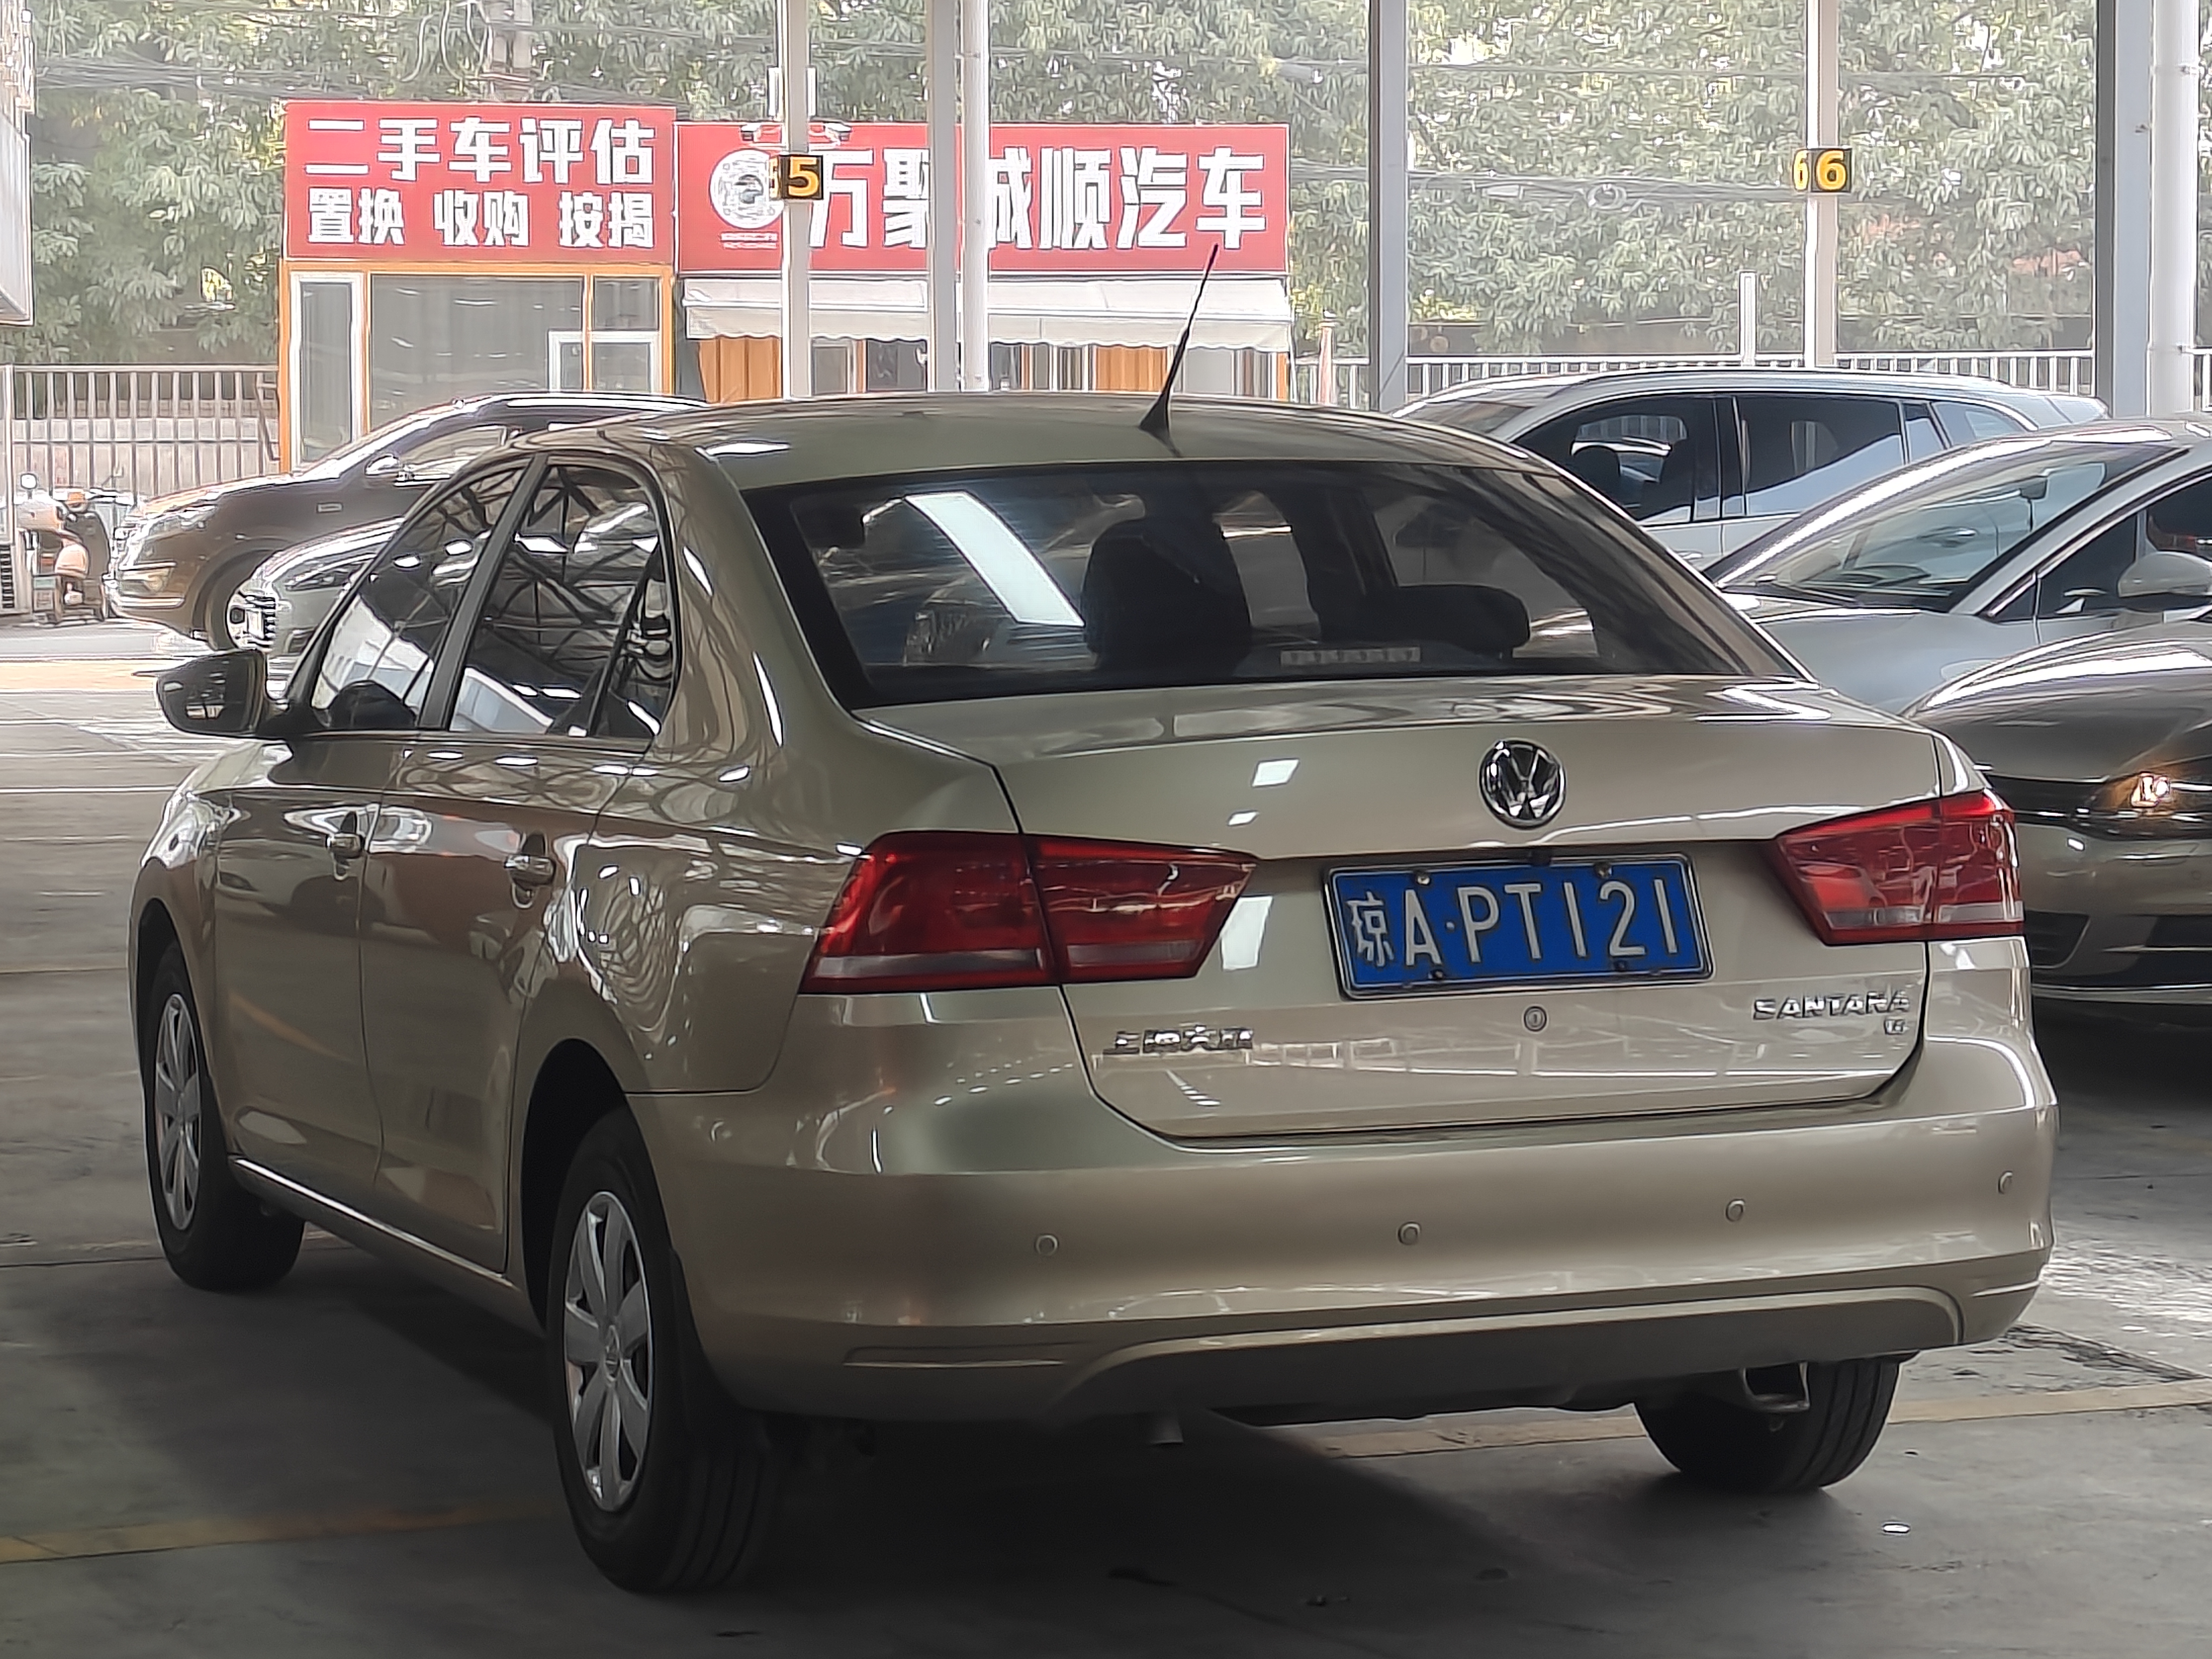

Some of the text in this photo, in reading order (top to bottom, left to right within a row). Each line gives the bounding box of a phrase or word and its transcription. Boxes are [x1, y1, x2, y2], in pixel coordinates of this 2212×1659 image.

[305, 116, 656, 185] 二手车评估
[1816, 150, 1847, 191] 6
[788, 156, 819, 197] 5
[307, 187, 655, 248] 置换 收购 按揭
[1753, 990, 1911, 1021] SANTANA
